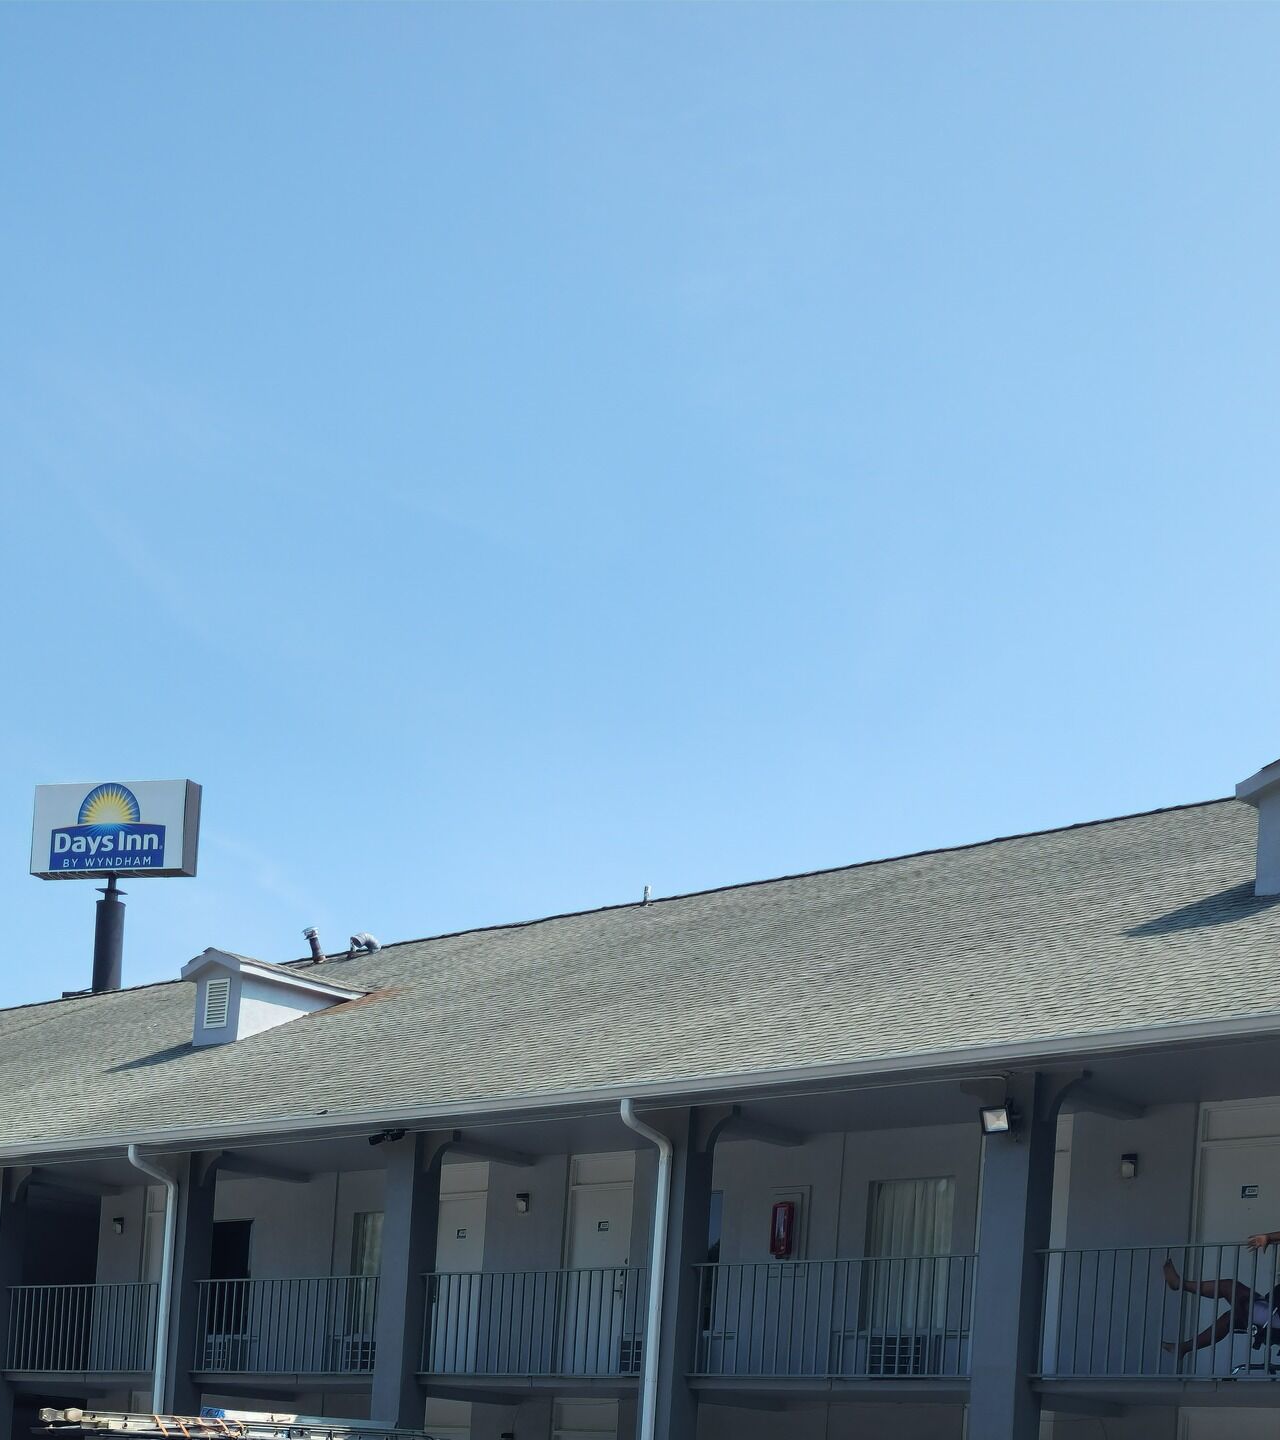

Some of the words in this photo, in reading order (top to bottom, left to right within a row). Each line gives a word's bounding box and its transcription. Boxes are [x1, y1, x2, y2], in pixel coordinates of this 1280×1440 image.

[54, 832, 114, 856] Days
[118, 830, 158, 851] Inn
[62, 858, 79, 868] BY
[85, 856, 152, 867] WYNDHAM
